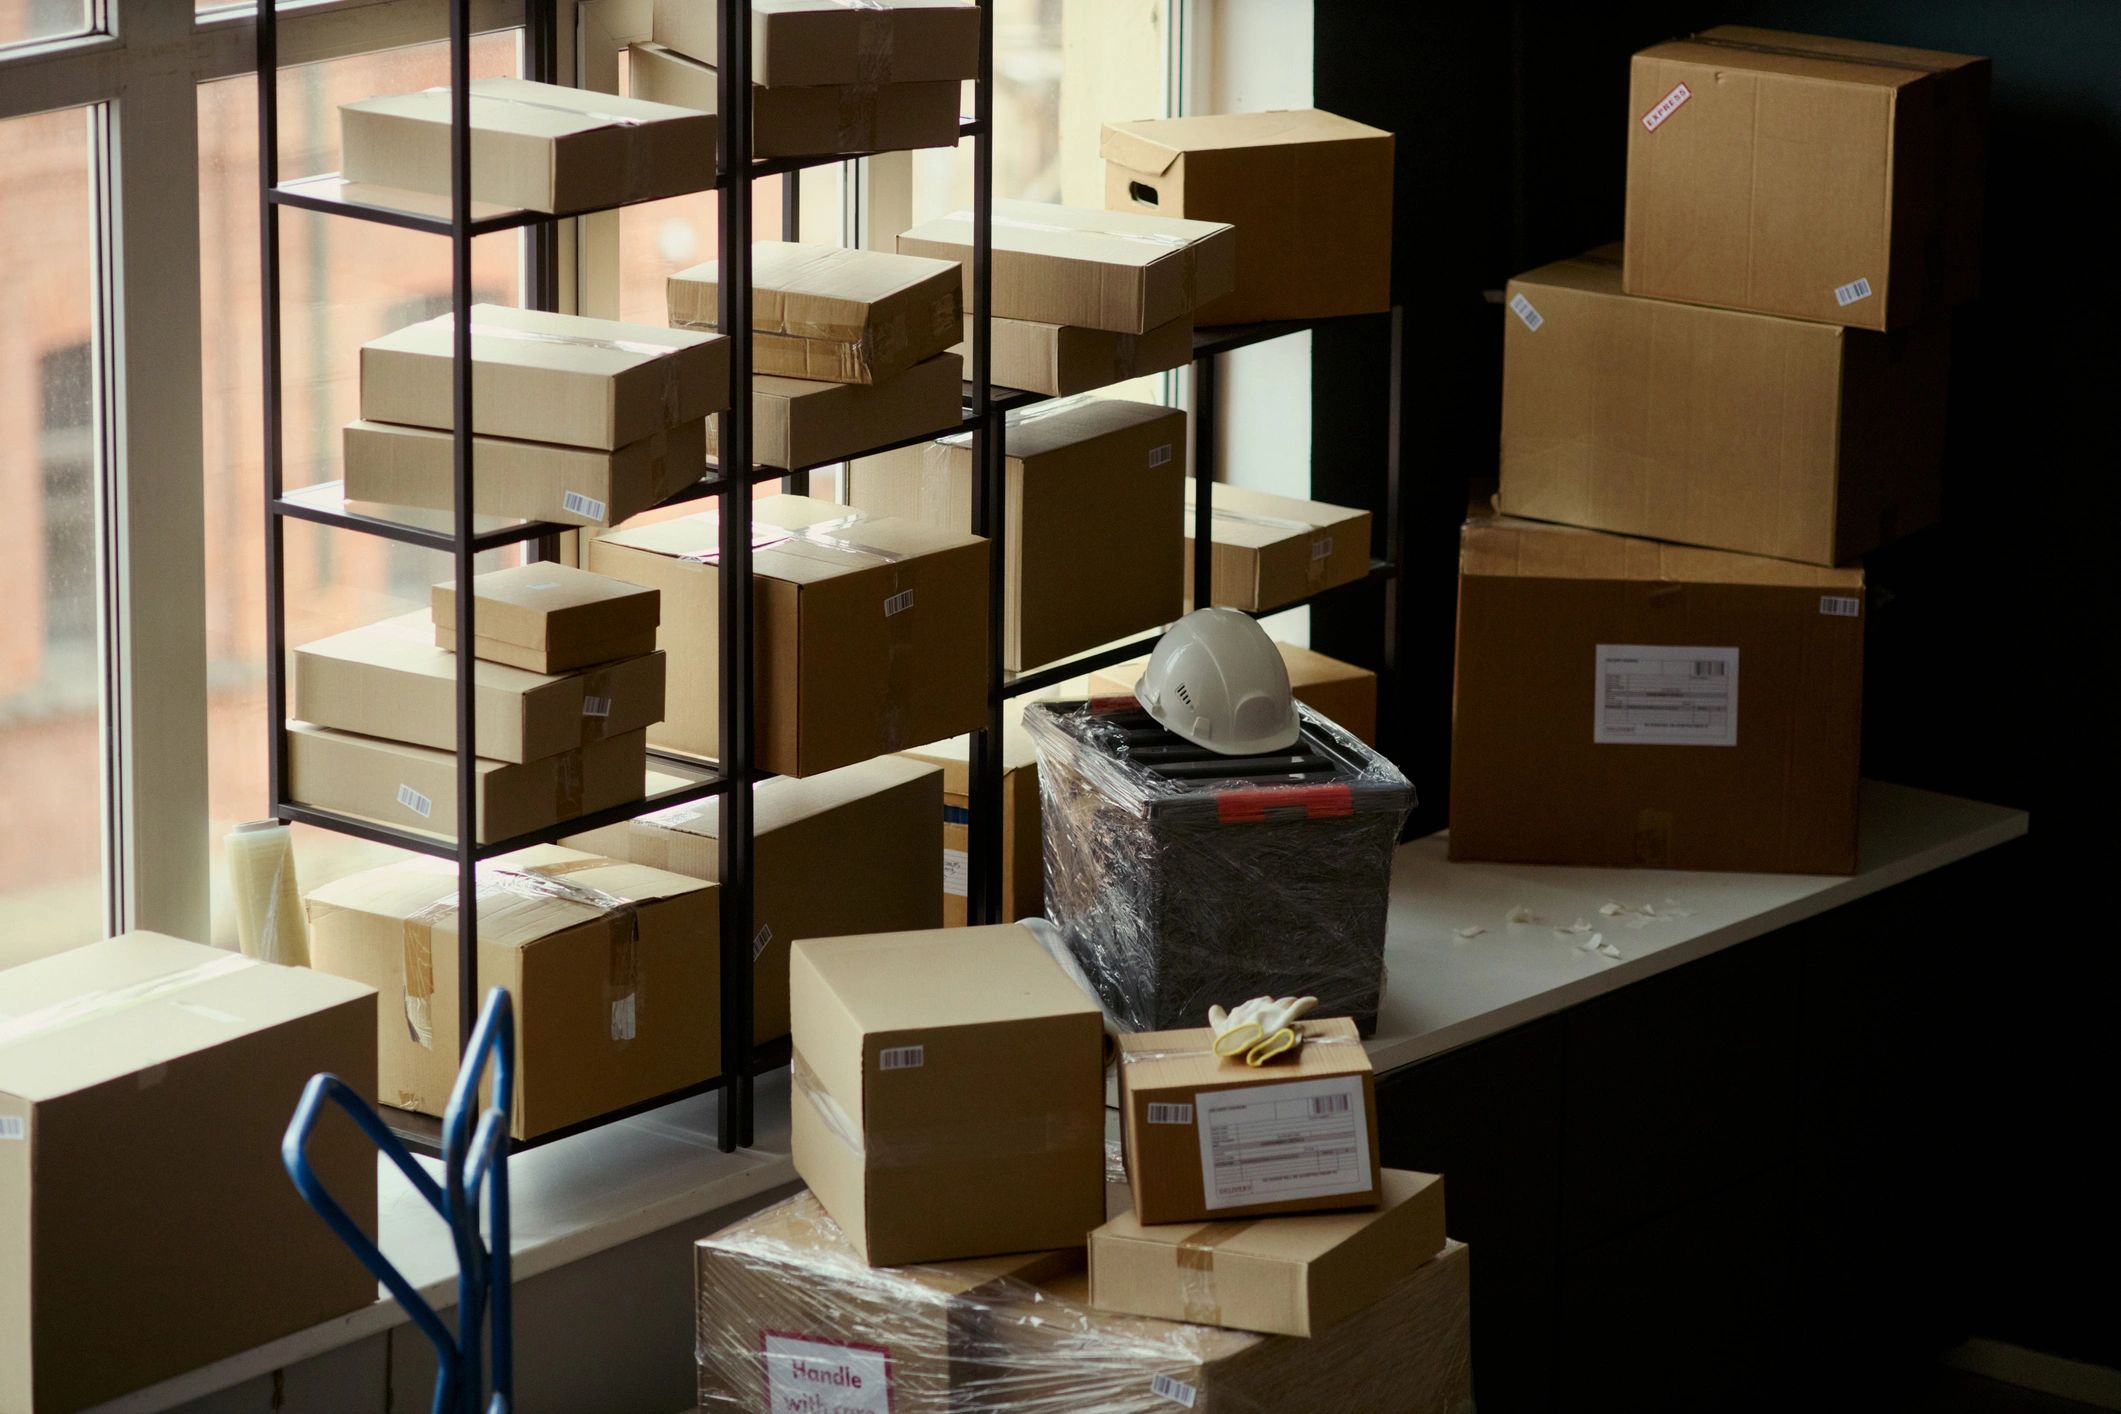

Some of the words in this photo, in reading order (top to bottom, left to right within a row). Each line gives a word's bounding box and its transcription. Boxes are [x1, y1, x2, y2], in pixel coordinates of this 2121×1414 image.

[1645, 89, 1687, 127] EXPRESS
[792, 1360, 862, 1389] Handle
[783, 1393, 828, 1414] with
